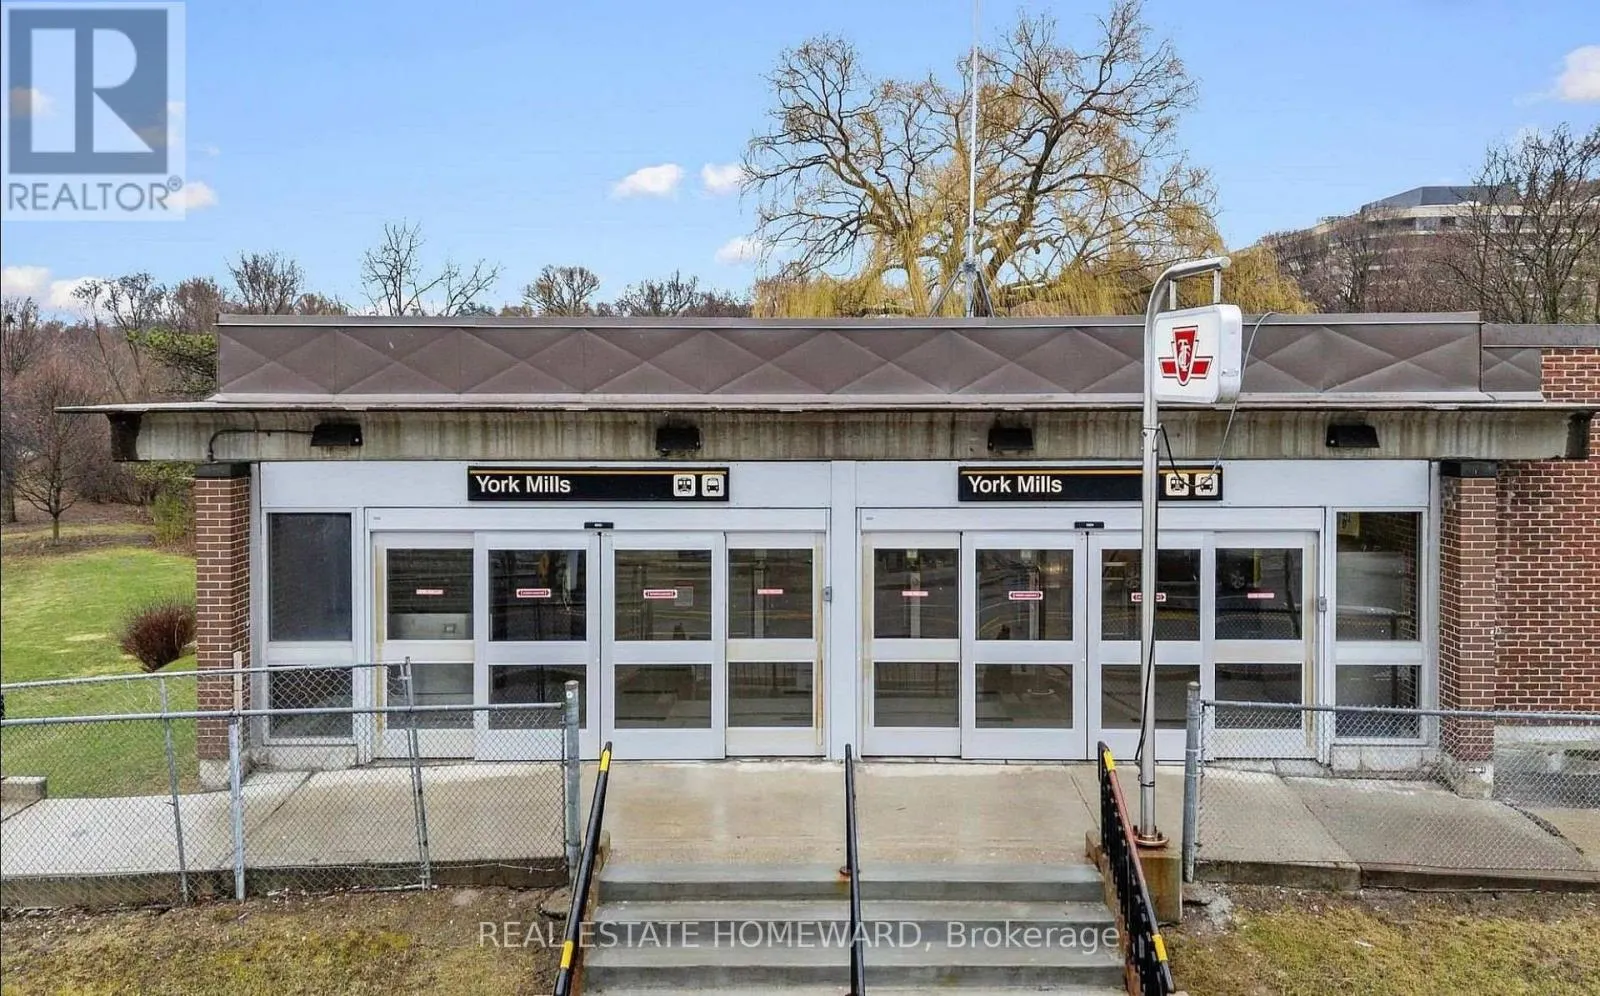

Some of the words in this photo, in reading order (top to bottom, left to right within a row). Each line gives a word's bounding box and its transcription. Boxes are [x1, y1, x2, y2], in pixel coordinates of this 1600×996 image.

[475, 475, 520, 493] York
[526, 475, 571, 493] Mills
[968, 475, 1011, 493] York
[1017, 475, 1063, 493] Mills
